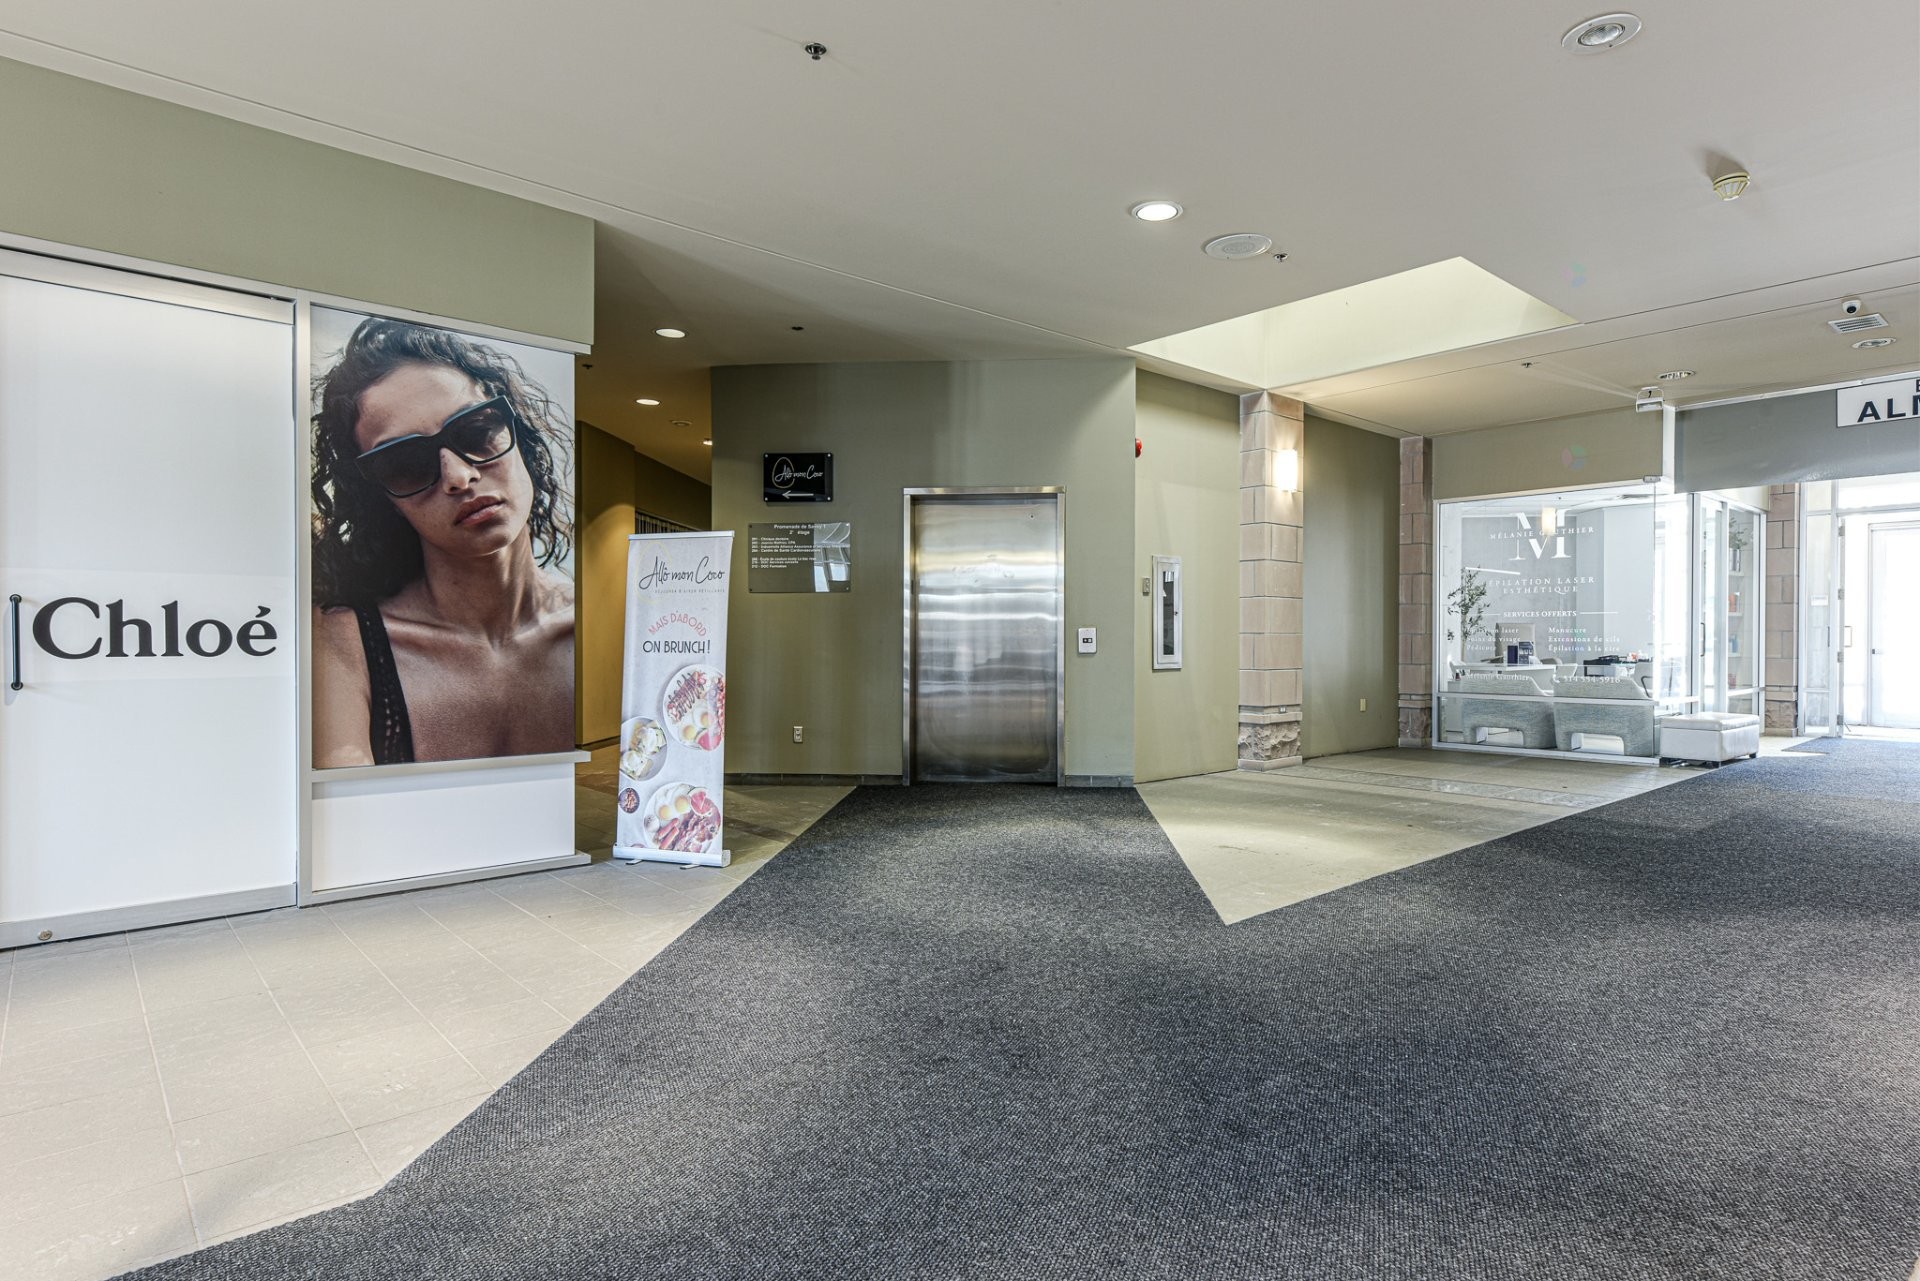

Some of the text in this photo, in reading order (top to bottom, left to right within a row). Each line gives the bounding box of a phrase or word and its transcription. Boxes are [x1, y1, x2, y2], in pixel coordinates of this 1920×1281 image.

[671, 570, 694, 582] mon
[695, 555, 725, 585] Coco
[1557, 576, 1595, 585] LASER
[1503, 584, 1579, 595] ESTHÉTIQUE
[32, 596, 278, 660] Chloé
[648, 615, 669, 636] MAIS
[642, 640, 661, 653] ON
